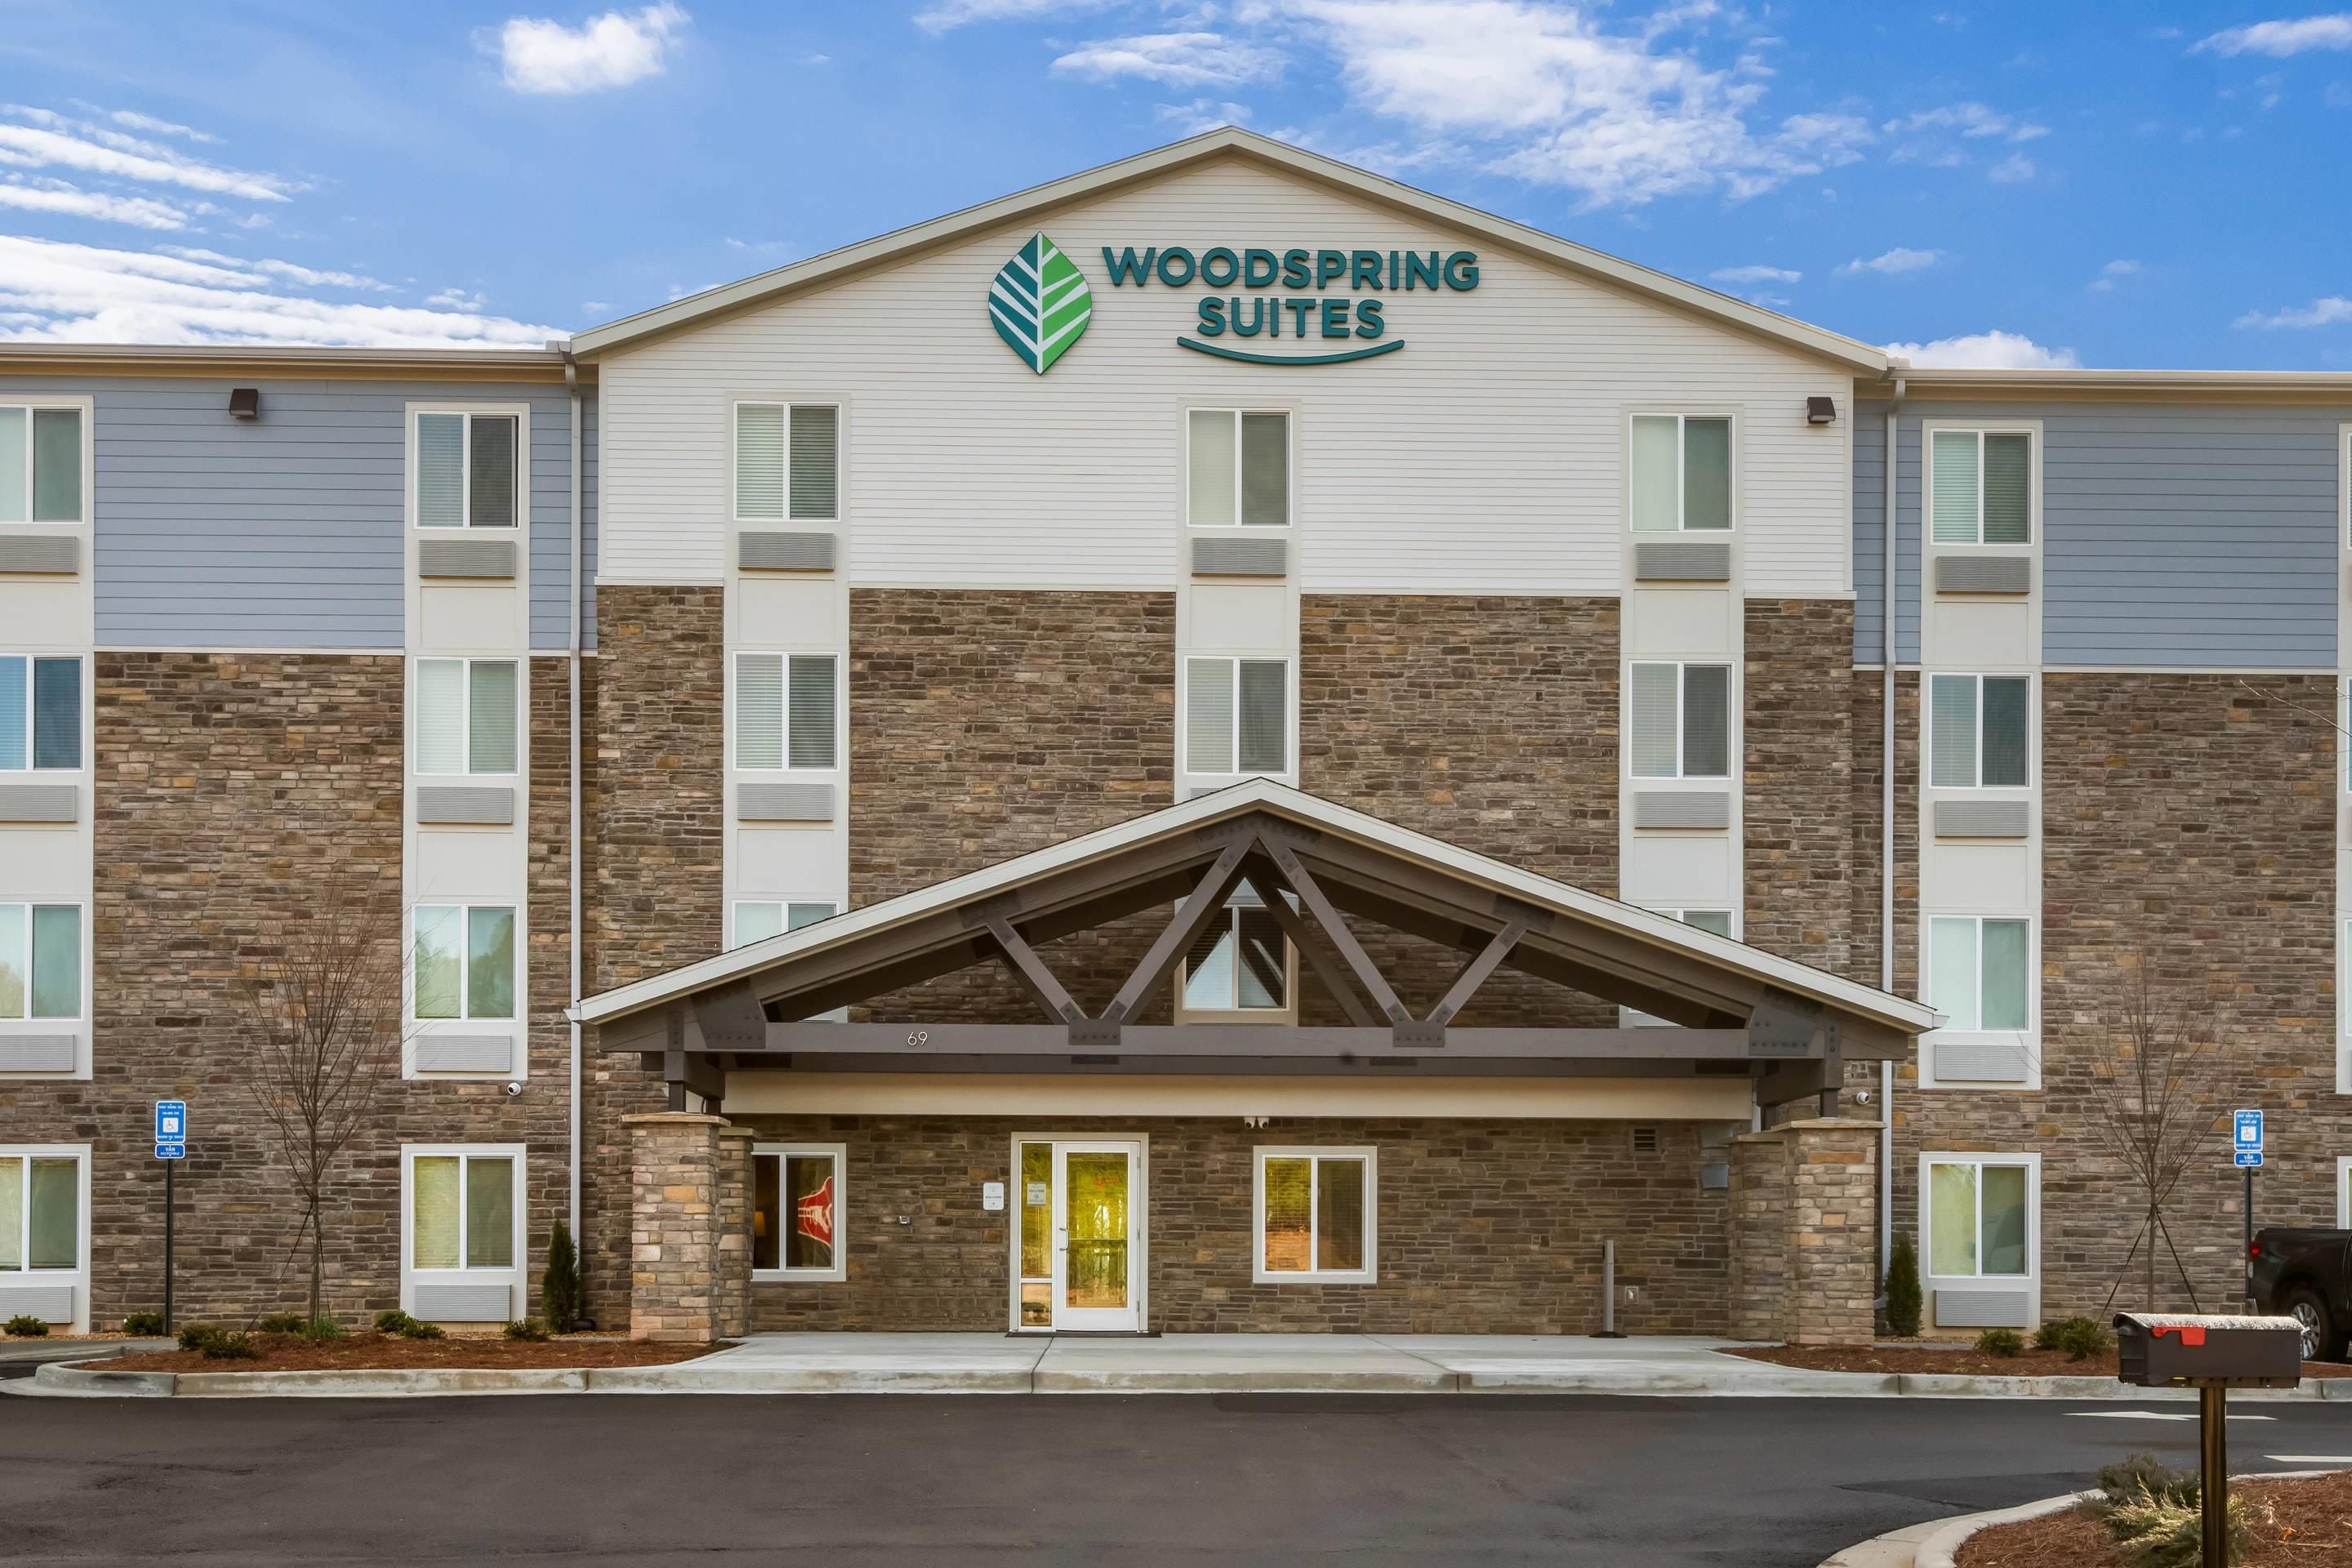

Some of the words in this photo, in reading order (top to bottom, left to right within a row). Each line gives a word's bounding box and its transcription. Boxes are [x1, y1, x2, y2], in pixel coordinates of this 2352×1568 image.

[1102, 247, 1480, 291] WOODSPRING
[1196, 296, 1385, 338] SUITES
[907, 1031, 928, 1046] 69
